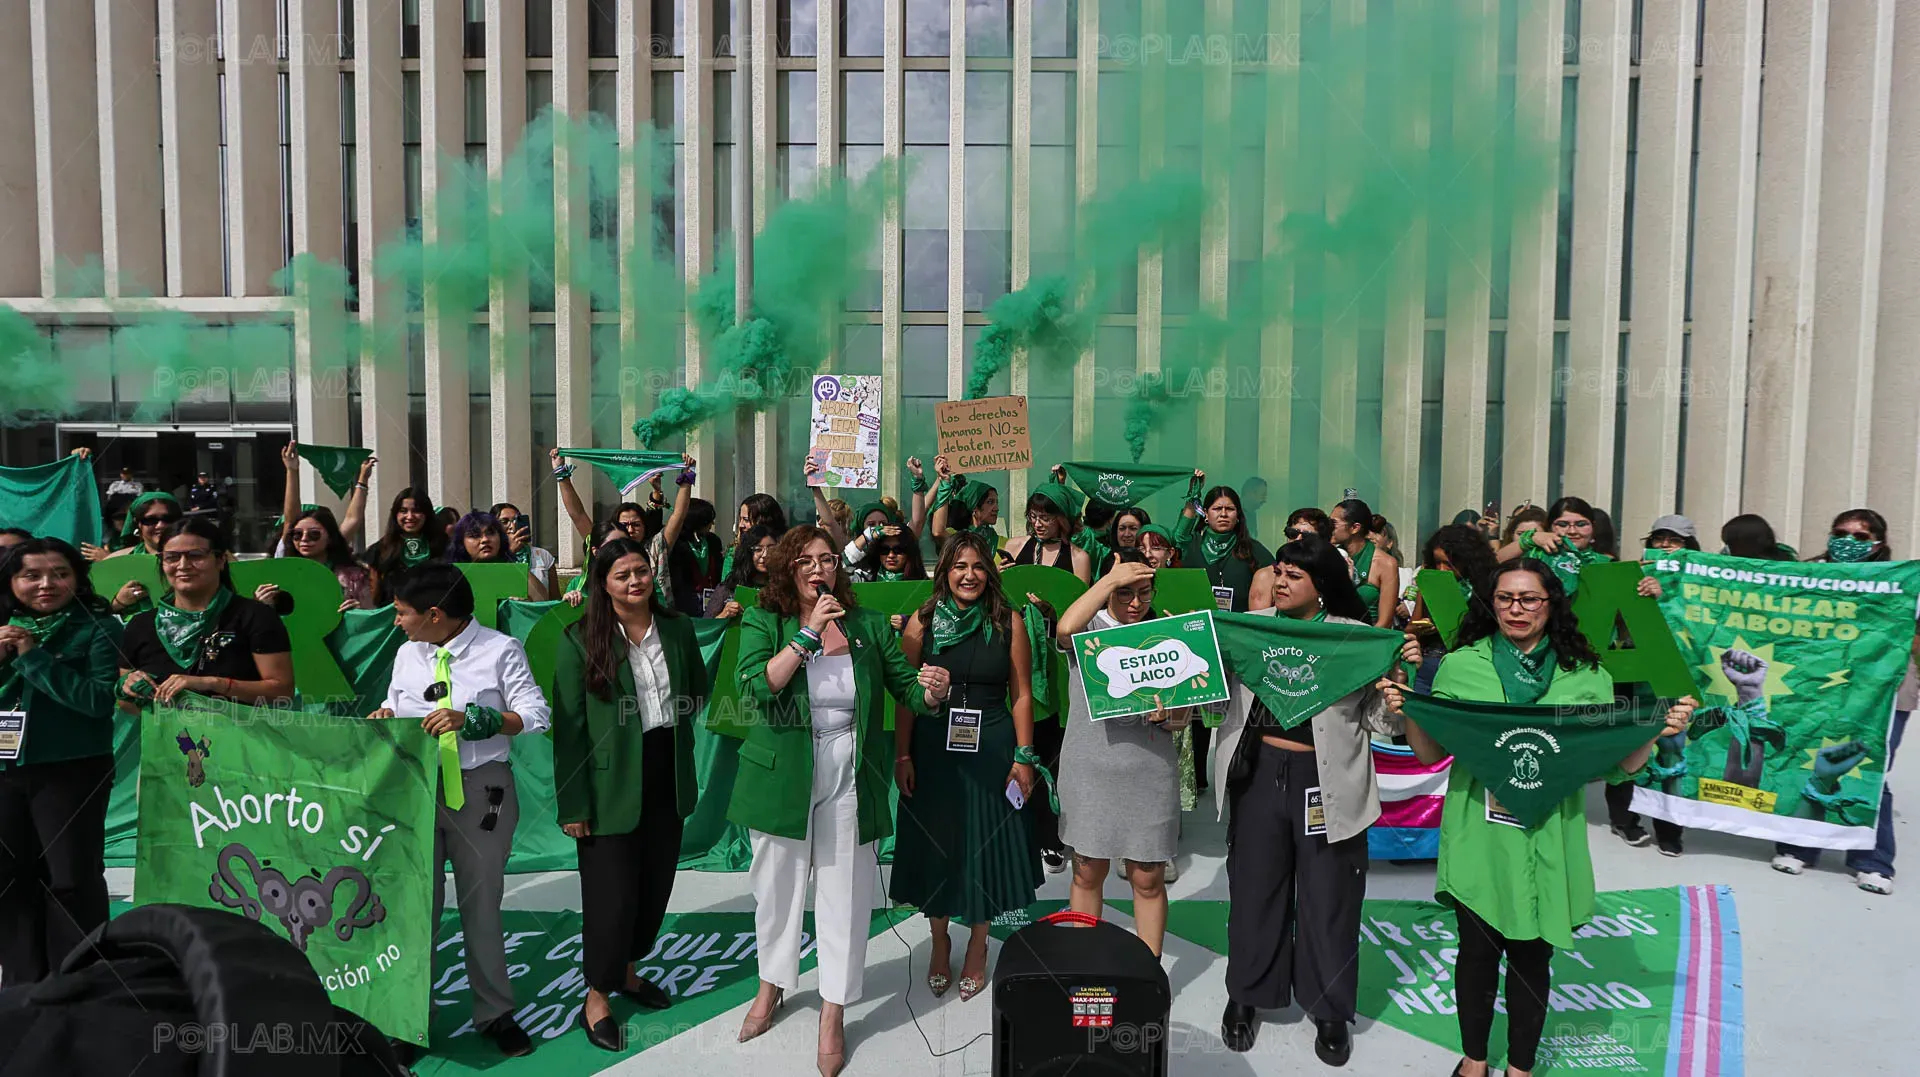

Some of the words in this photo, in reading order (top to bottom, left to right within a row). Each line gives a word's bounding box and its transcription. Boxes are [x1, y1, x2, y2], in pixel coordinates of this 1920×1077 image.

[941, 408, 960, 424] Los
[968, 405, 1018, 421] derechos
[940, 426, 983, 439] humanos
[989, 421, 1011, 438] NO
[1013, 426, 1026, 435] se
[1001, 439, 1017, 449] se
[958, 449, 1030, 468] GARANTIZAN
[1098, 472, 1124, 483] Aborto
[1656, 559, 1681, 572] ES
[1685, 562, 1903, 594] INCONSTITUCIONAL
[1683, 583, 1858, 619] PENALIZAR
[1684, 604, 1718, 625] EL
[1724, 612, 1861, 641] ABORTO
[1119, 650, 1180, 670] ESTADO
[1261, 646, 1304, 662] Aborto
[1306, 654, 1321, 665] sí
[1130, 666, 1176, 684] LAICO
[1262, 676, 1310, 697] Criminalización
[1310, 684, 1319, 692] no
[190, 786, 324, 848] Aborto
[340, 824, 396, 861] sí
[1412, 921, 1456, 940] ES
[376, 944, 401, 972] no
[537, 964, 739, 999] MDRE
[1386, 981, 1653, 1015] NEARIO
[1564, 1045, 1635, 1057] DERECHO
[1566, 1058, 1580, 1068] A
[1577, 1056, 1641, 1068] DECIDIR
